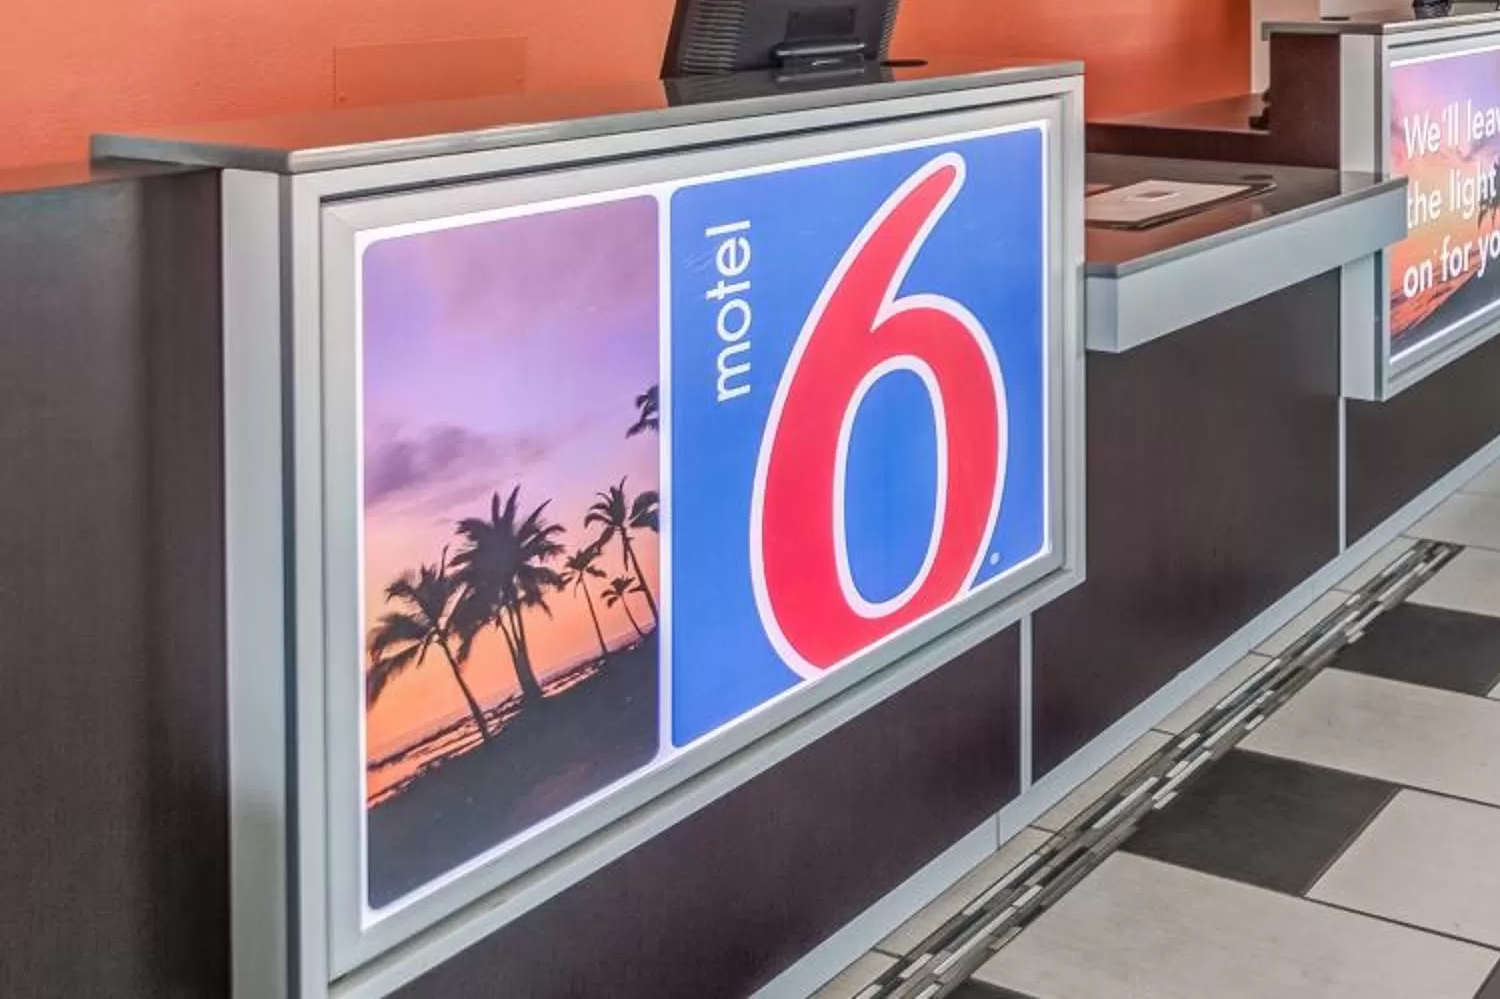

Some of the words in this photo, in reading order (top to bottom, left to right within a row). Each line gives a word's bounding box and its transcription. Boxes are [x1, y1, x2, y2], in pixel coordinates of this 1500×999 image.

[1403, 104, 1459, 159] We'll
[1405, 178, 1442, 229] the
[1449, 159, 1498, 219] light
[1403, 258, 1433, 299] on
[1439, 234, 1472, 282] for
[705, 220, 751, 401] motel
[749, 151, 1009, 682] 6
